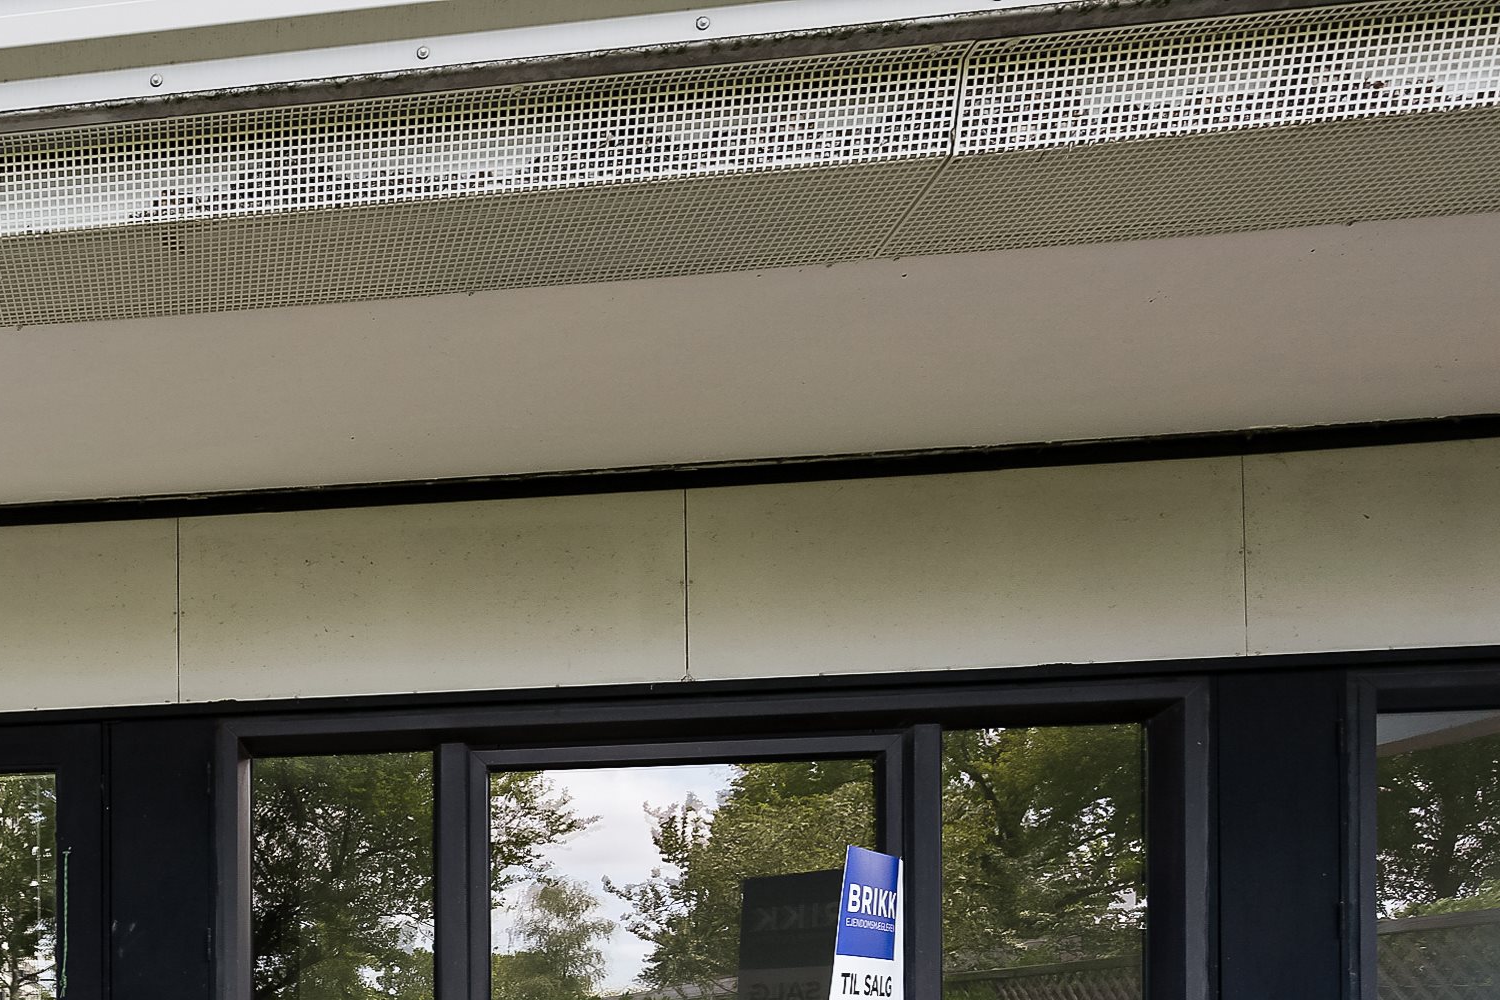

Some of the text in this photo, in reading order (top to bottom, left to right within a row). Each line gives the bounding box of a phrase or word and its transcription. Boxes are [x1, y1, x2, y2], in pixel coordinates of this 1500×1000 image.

[847, 883, 897, 920] BRIKK
[841, 972, 892, 998] TIL SALG
